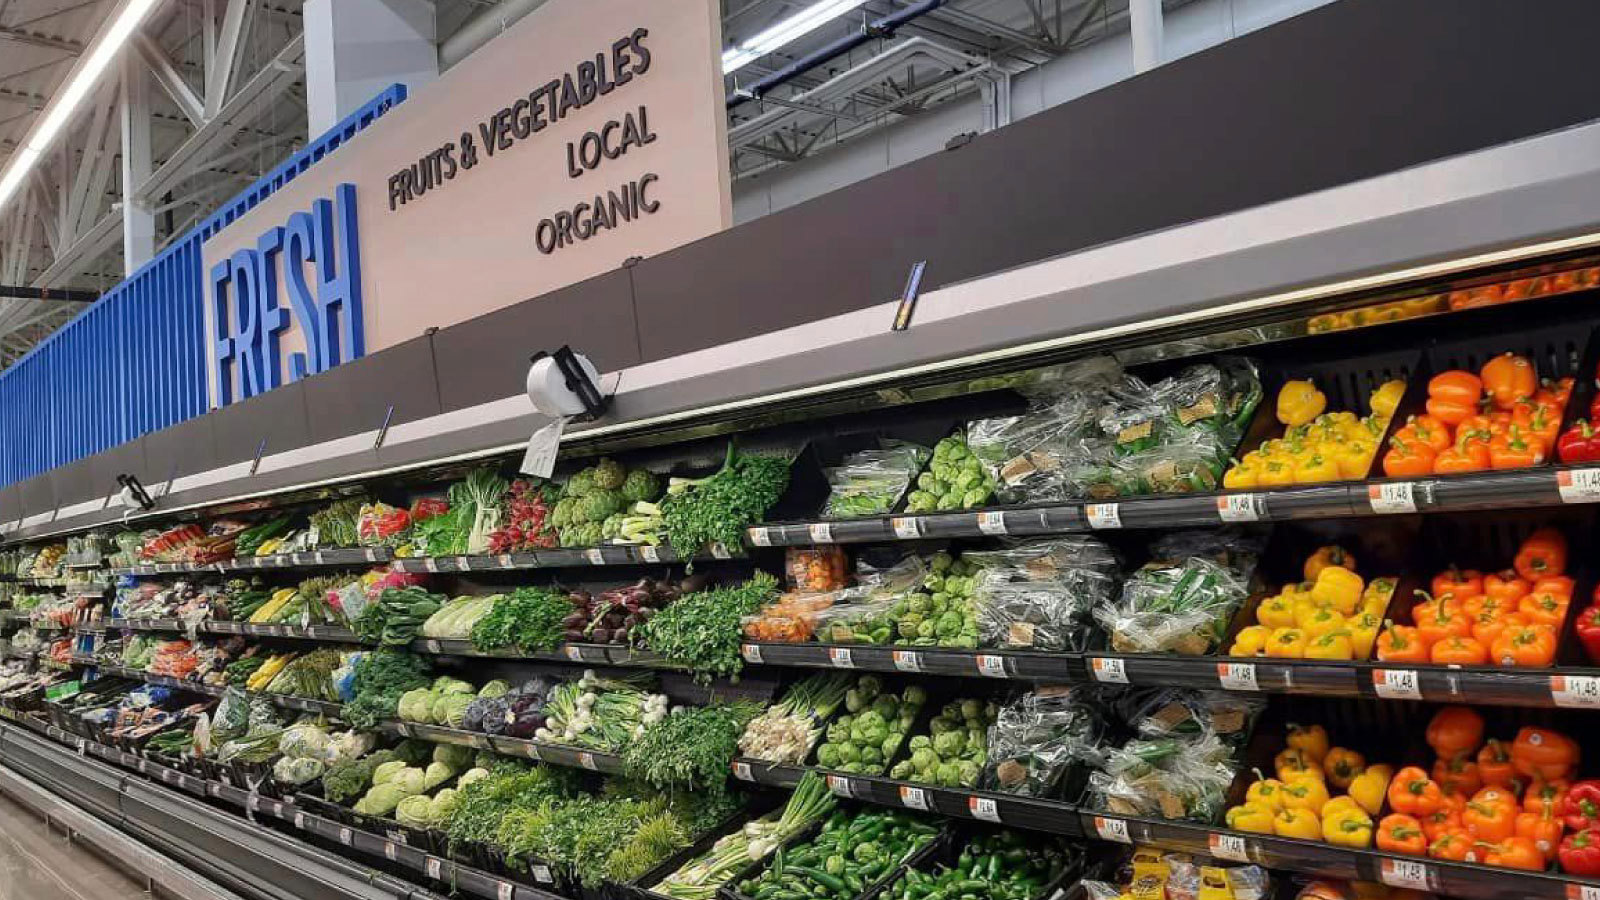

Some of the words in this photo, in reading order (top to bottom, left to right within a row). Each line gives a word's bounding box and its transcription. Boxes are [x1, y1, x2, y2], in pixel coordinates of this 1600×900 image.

[387, 143, 457, 211] FRUITS
[460, 131, 478, 170] &
[480, 27, 651, 156] VEGETABLES
[566, 106, 657, 178] LOCAL
[535, 173, 661, 255] ORGANIC
[210, 182, 366, 409] FRESH
